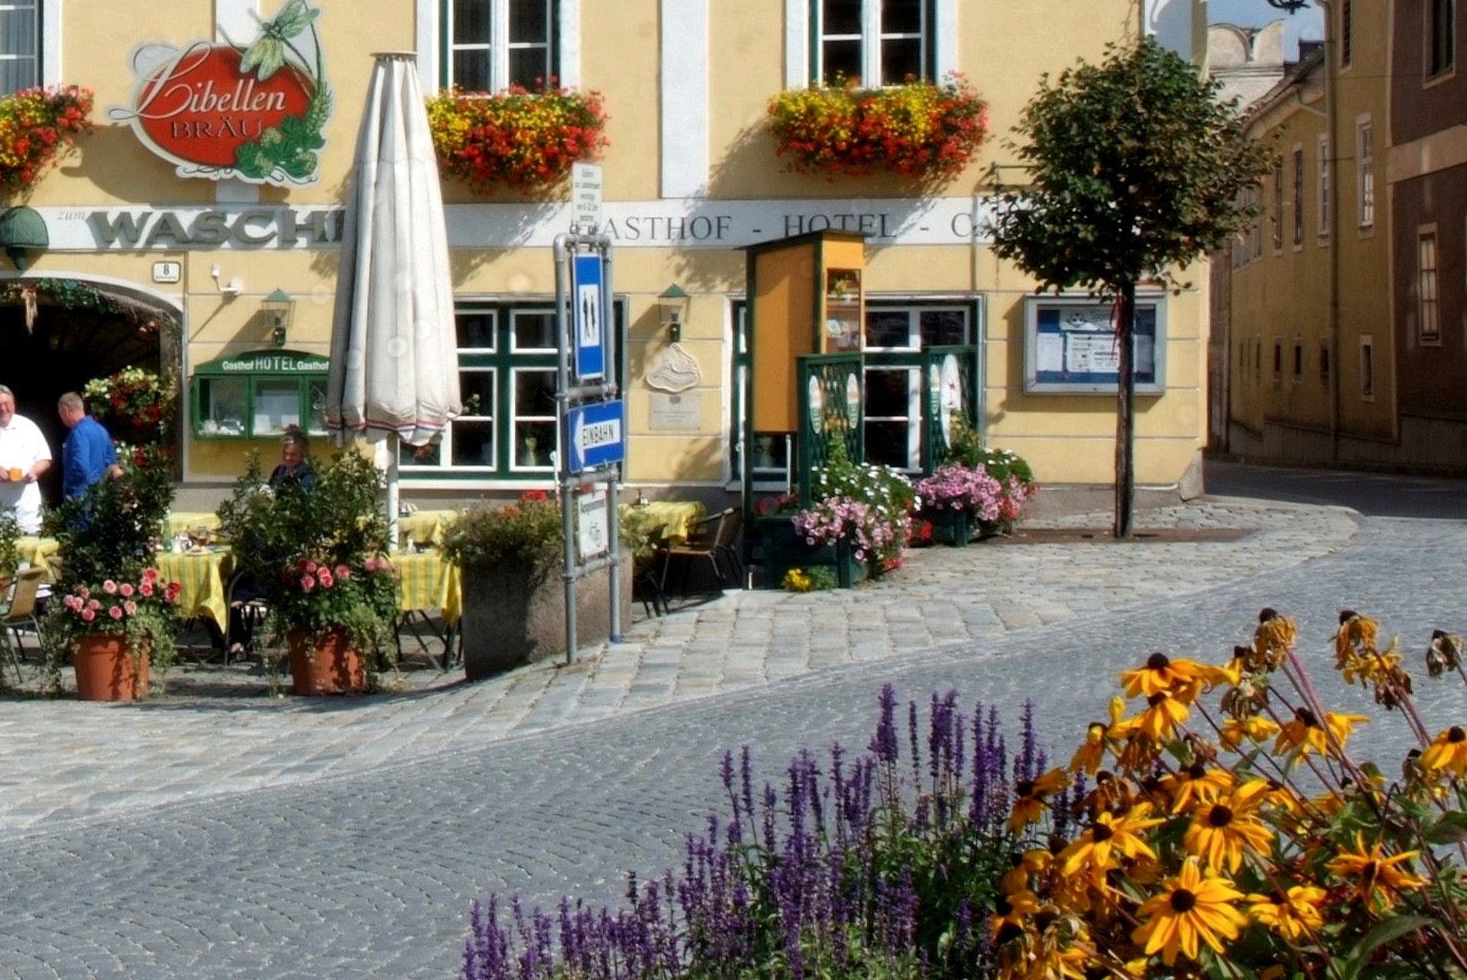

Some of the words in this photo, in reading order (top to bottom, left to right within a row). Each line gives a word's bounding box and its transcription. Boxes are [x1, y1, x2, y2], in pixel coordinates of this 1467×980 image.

[108, 41, 286, 120] Libellen
[172, 117, 263, 139] BRÄU
[602, 215, 733, 241] ASTHOF
[783, 213, 898, 238] HOTEL
[163, 264, 170, 276] 8
[222, 360, 254, 370] Gasthof
[255, 356, 297, 370] HOTEL
[297, 360, 330, 370] Gasthof
[582, 422, 614, 447] EINBAHN
